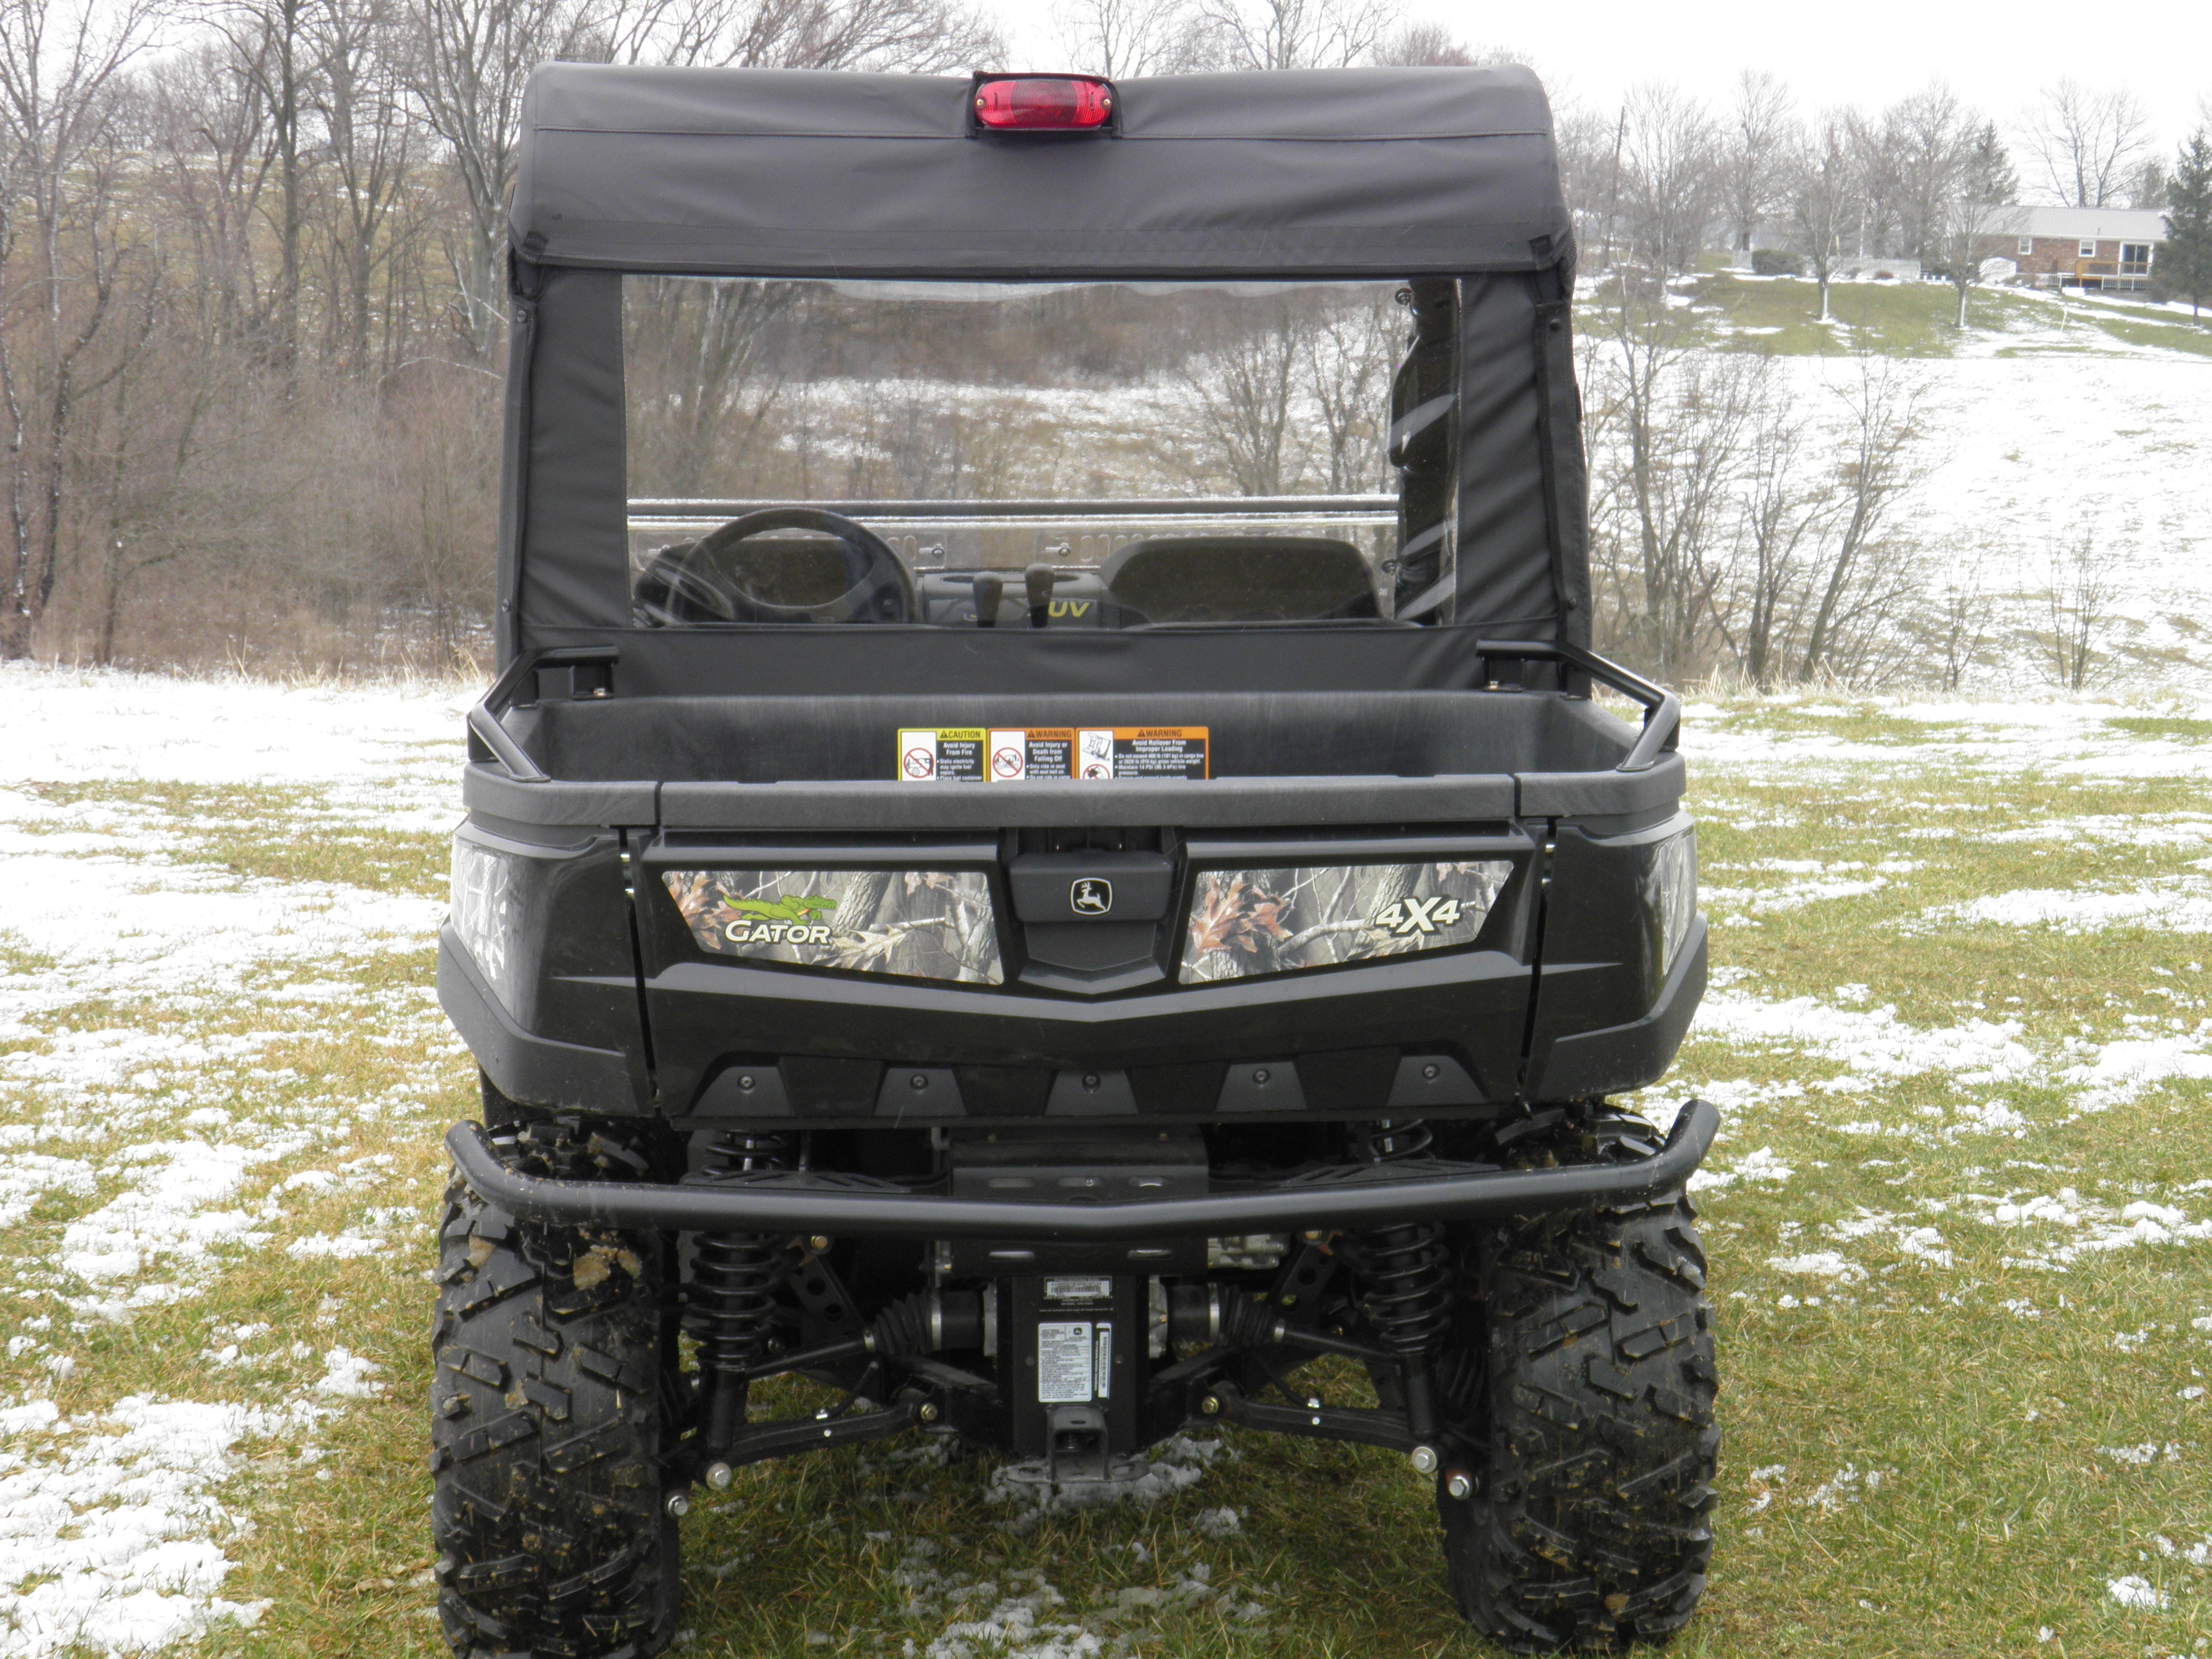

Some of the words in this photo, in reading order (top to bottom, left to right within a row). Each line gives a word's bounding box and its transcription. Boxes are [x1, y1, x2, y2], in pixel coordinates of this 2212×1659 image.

[1027, 601, 1090, 617] UV
[1036, 730, 1071, 738] WARNING
[1375, 897, 1461, 934] 4X4
